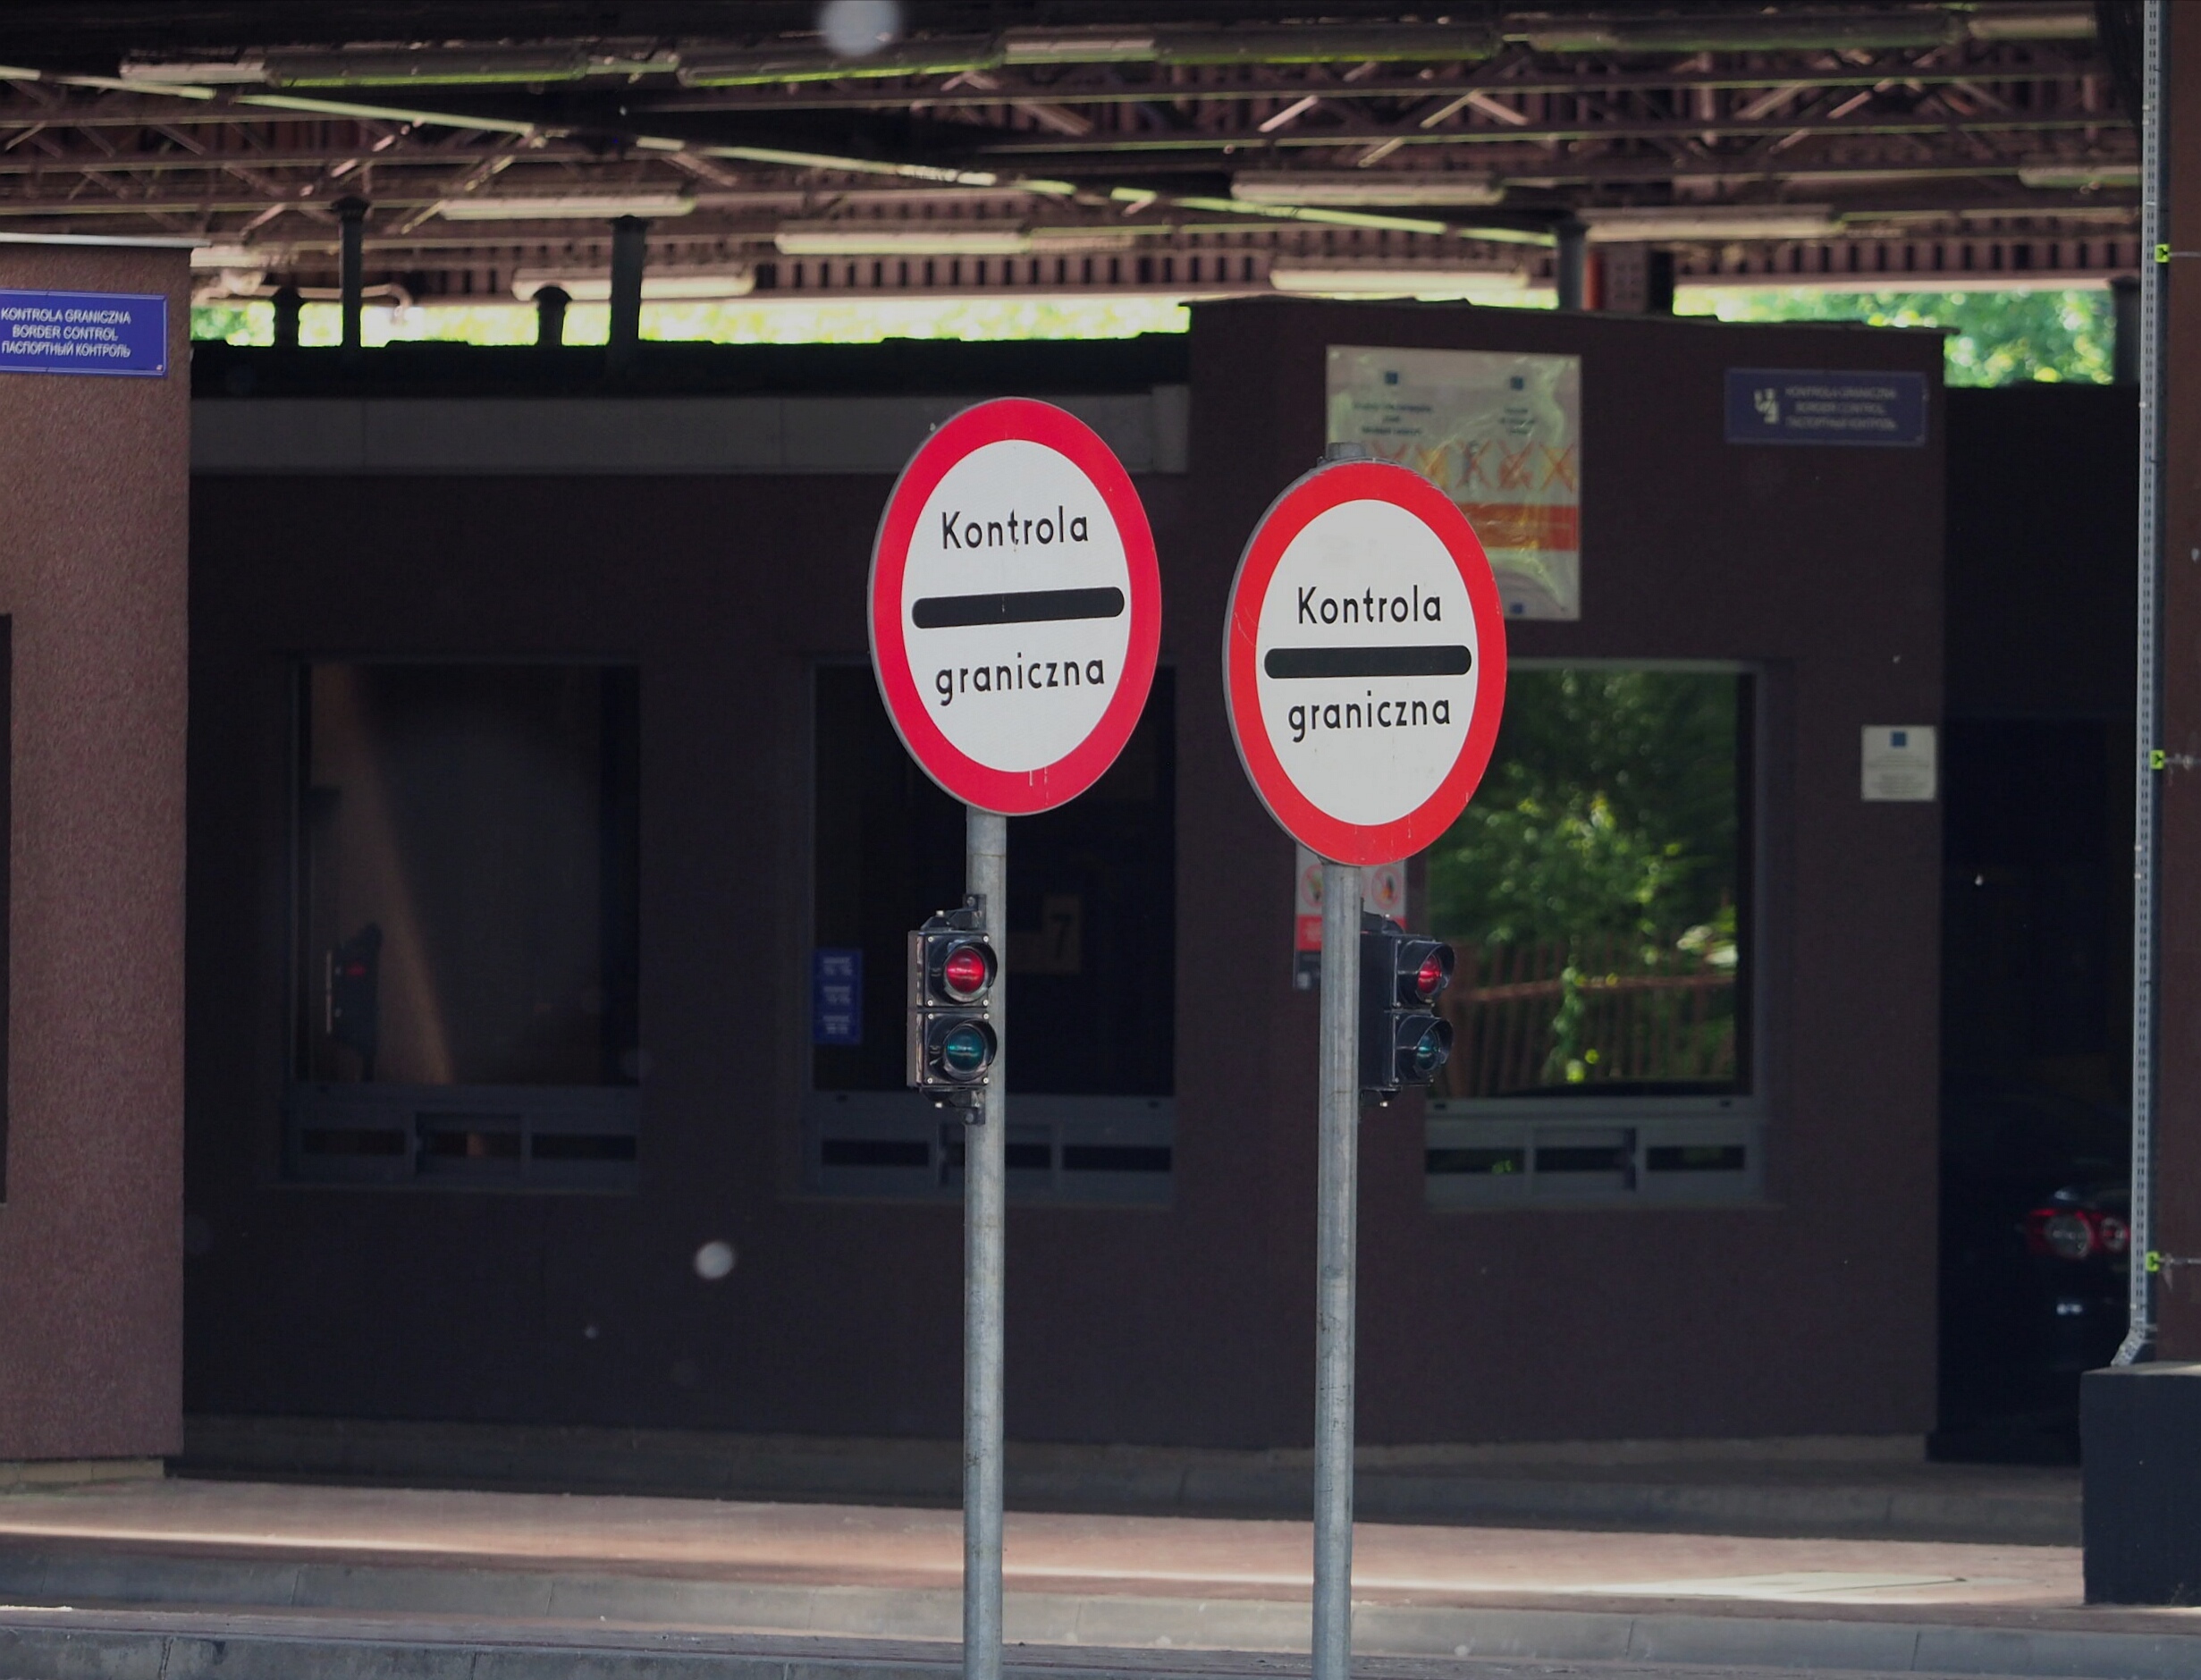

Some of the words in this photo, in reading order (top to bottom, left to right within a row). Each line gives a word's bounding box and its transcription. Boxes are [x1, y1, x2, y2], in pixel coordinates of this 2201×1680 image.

[1, 308, 63, 323] KONTROLA
[65, 309, 131, 325] GRANICZNA
[13, 325, 61, 339] BORDER
[63, 326, 119, 342] CONTROL
[2, 340, 74, 356] ПАСПОРТНЫЙ
[75, 342, 131, 358] КОНТРОЛЬ
[941, 505, 1089, 549] Kontrola
[1298, 584, 1442, 624] Kontrola
[935, 653, 1105, 707] graniczna
[1288, 690, 1451, 743] graniczna
